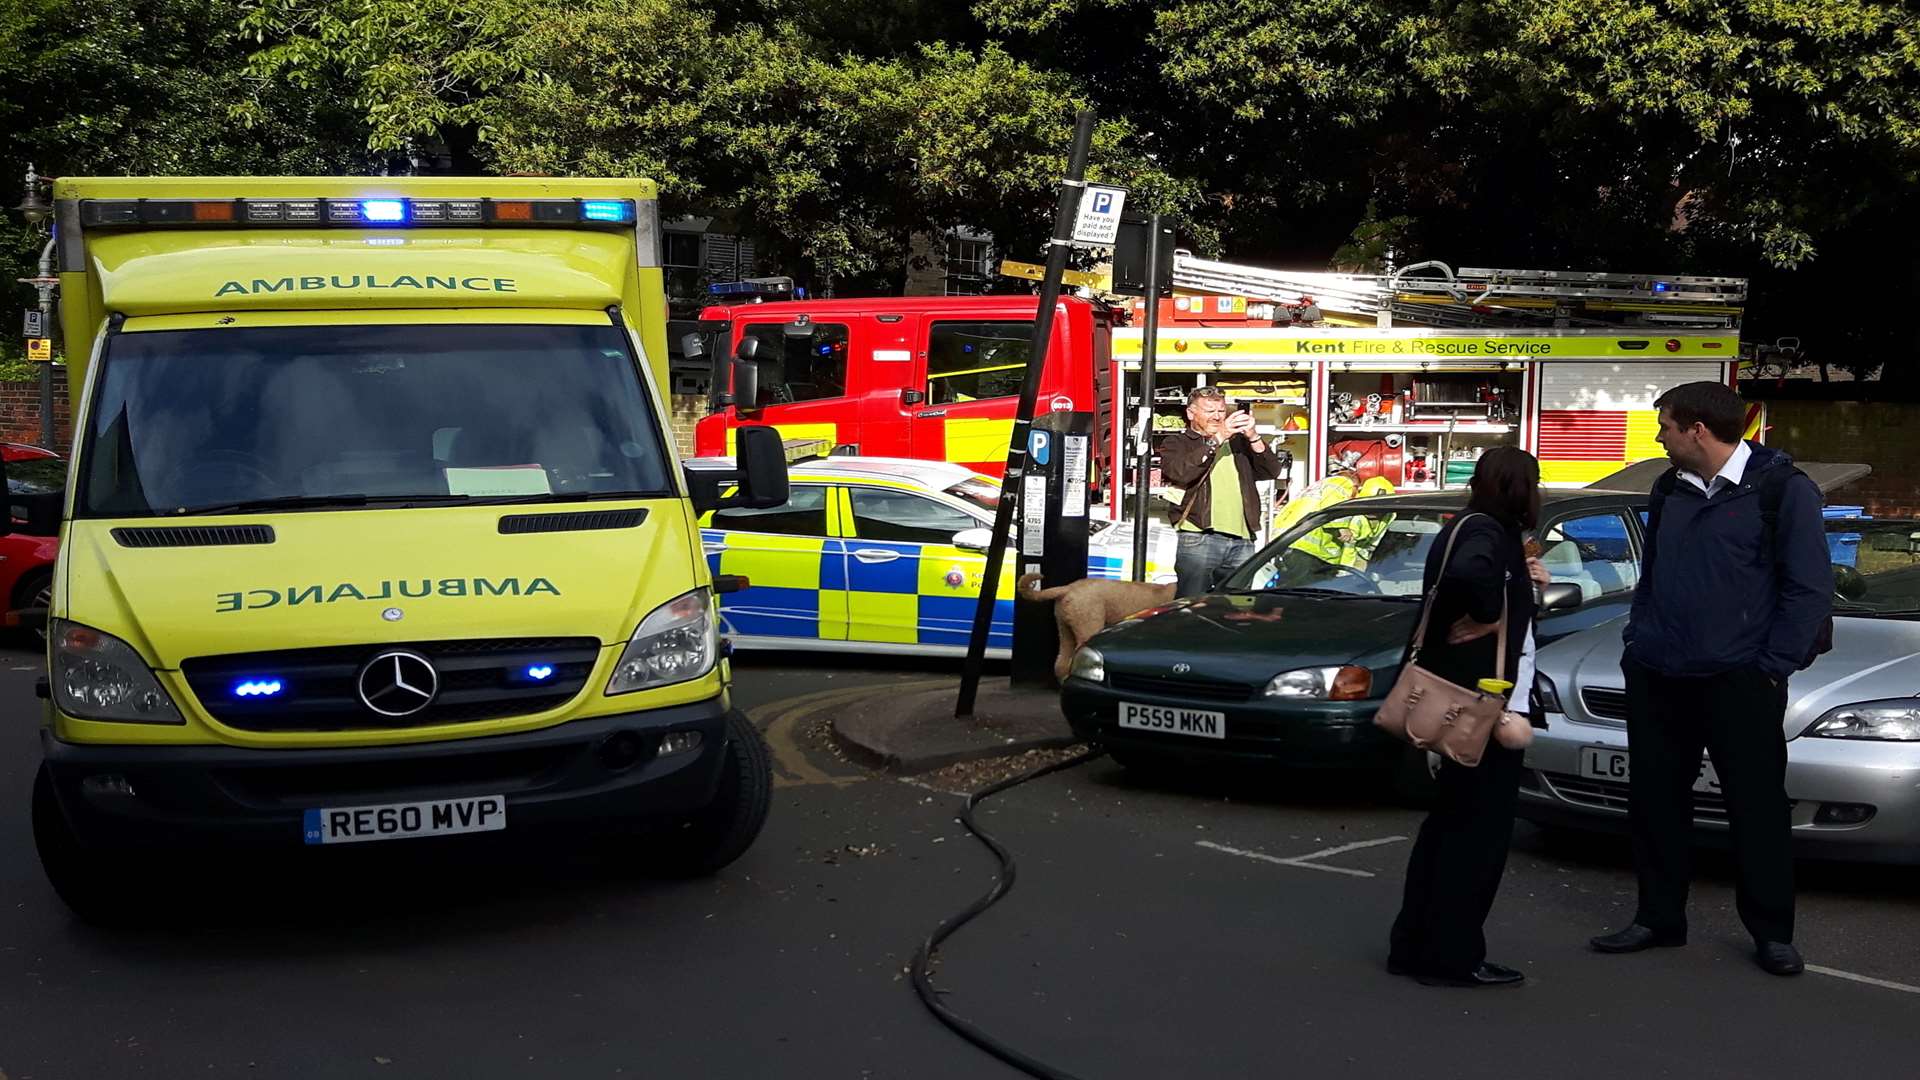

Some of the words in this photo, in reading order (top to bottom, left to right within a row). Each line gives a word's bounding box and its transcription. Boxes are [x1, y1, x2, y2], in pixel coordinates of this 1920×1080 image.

[215, 275, 518, 297] AMBULANCE
[1296, 341, 1345, 354] Kent
[1353, 340, 1386, 354] Fire
[1392, 341, 1404, 354] &
[1412, 340, 1478, 354] Rescue
[1484, 340, 1551, 354] Service
[1033, 433, 1047, 458] P
[1026, 517, 1042, 525] 4705
[1127, 706, 1175, 729] P559
[1180, 711, 1217, 735] MKN
[330, 806, 422, 838] RE60
[432, 799, 498, 830] MVP
